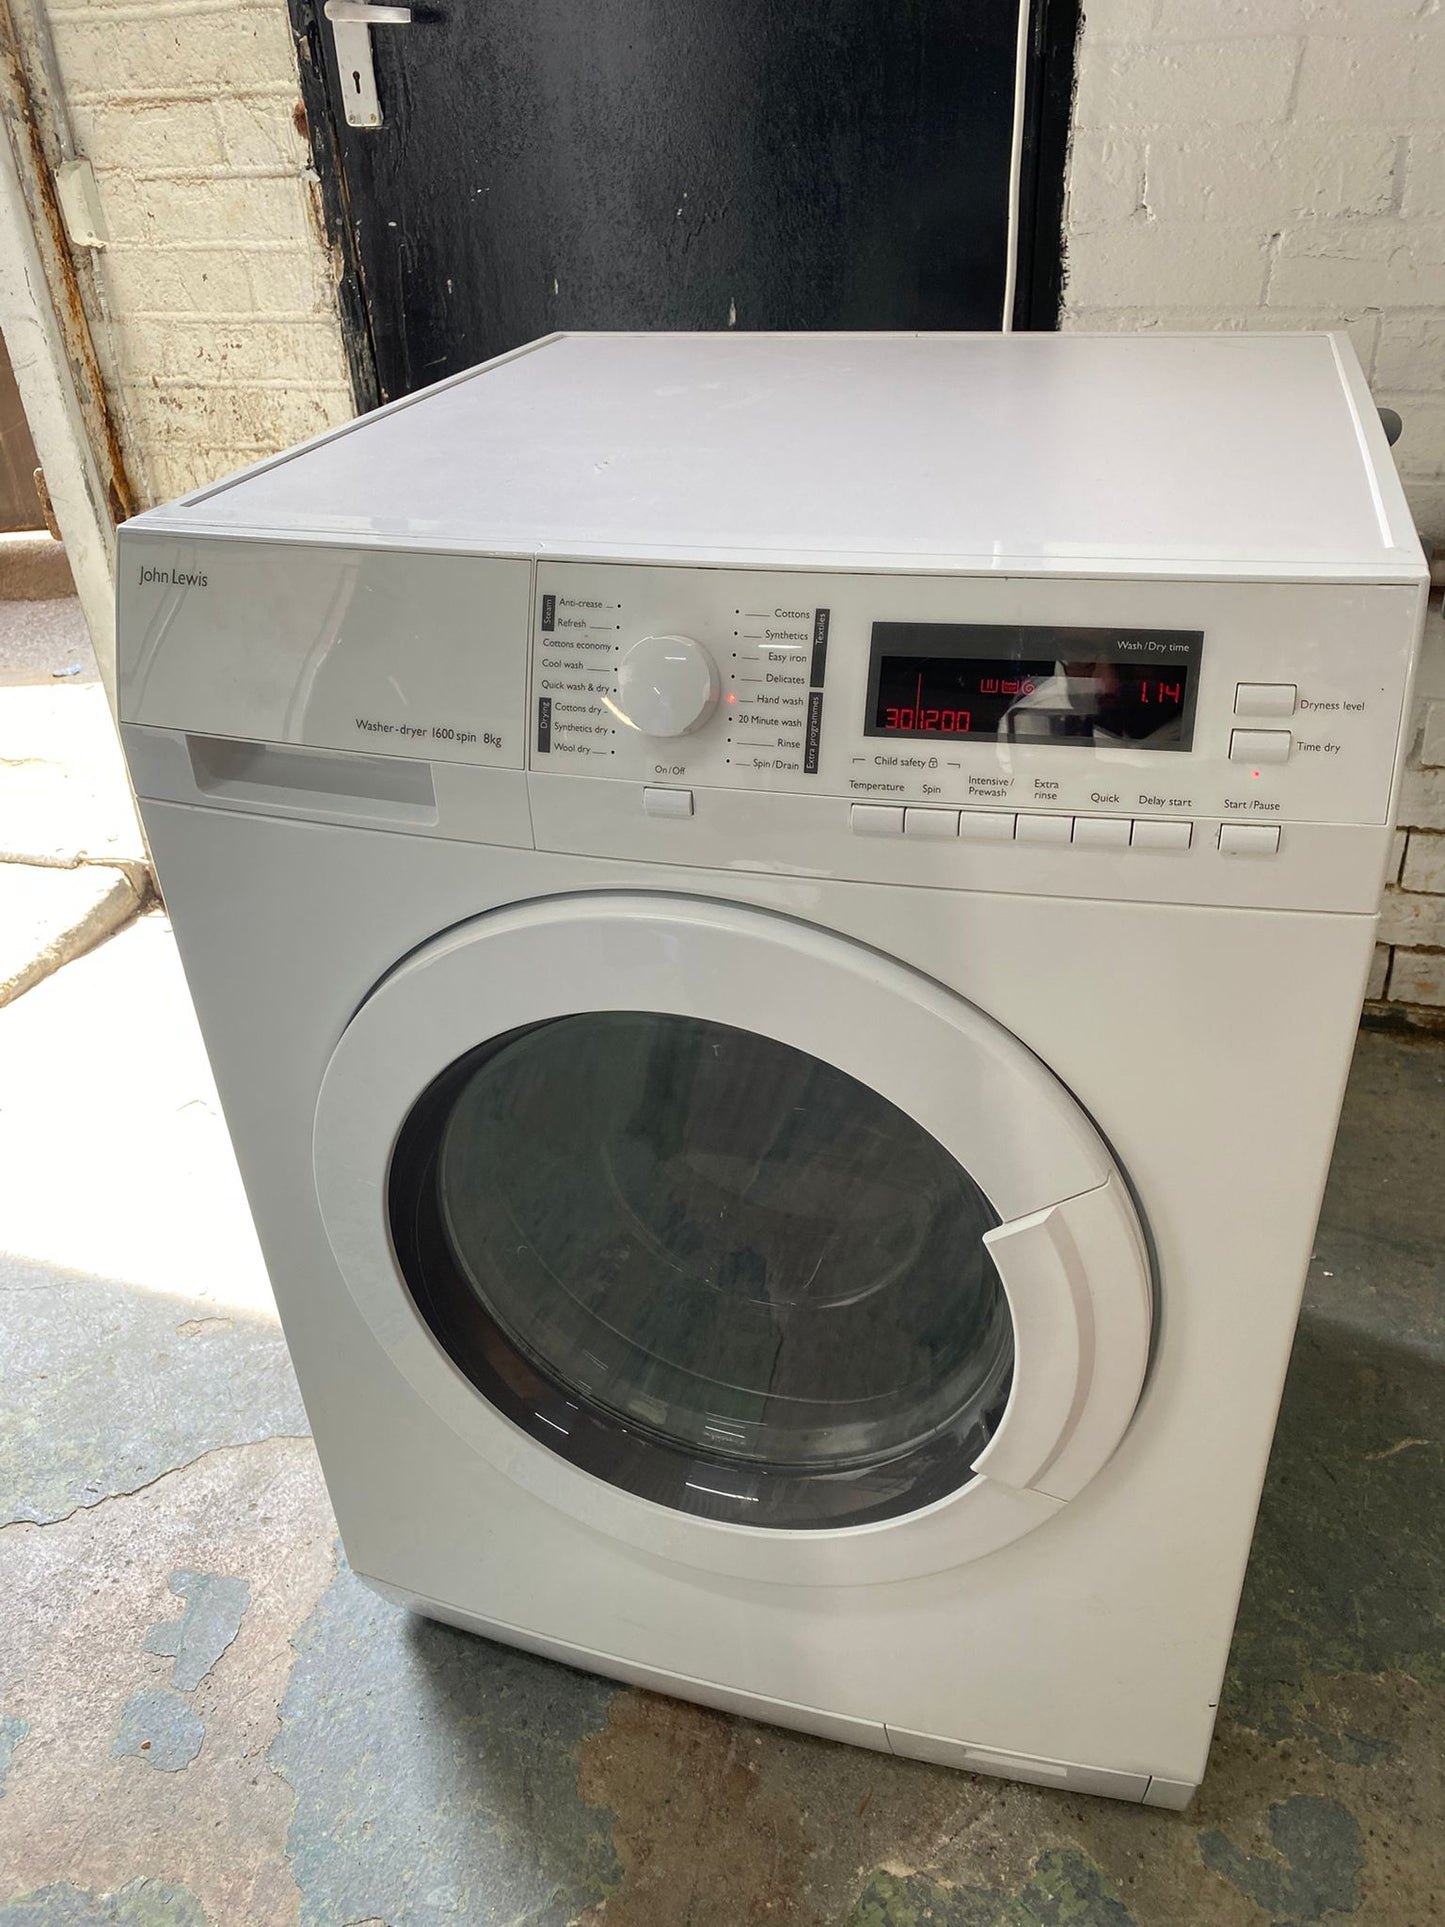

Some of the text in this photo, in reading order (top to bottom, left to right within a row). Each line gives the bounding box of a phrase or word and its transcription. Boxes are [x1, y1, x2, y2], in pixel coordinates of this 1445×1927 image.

[139, 566, 208, 587] John Lewis
[559, 598, 603, 609] Anti-crease
[544, 599, 553, 624] Steam
[774, 608, 810, 619] Cottons
[557, 618, 587, 628] Refresh
[815, 612, 826, 645] Textiles
[765, 629, 809, 641] Synthetics
[543, 638, 611, 652] Cottons economy
[1169, 642, 1190, 652] time
[768, 651, 787, 663] Easy
[542, 659, 584, 669] Cool wash
[766, 673, 805, 685] Delicates
[541, 679, 610, 695] Quick wash & dry
[756, 694, 804, 706] Hand wash
[1300, 699, 1365, 712] Dryness level
[541, 701, 550, 729] Drying
[554, 702, 602, 716] Cottons dry
[738, 714, 802, 728] 20 Minute wash
[355, 718, 502, 748] Washer-dryer 1600 spin 8kg
[554, 721, 609, 736] Synthetics dry
[805, 696, 820, 770] Extra programmes
[554, 743, 591, 756] Wool dry
[777, 738, 801, 749] Rinse
[1297, 741, 1341, 755] Time dry
[874, 755, 927, 769] Child safety
[849, 779, 905, 792] Temperature
[922, 784, 941, 795] Spin
[1034, 778, 1059, 789] Extra
[968, 786, 1007, 797] Prewash
[1034, 790, 1057, 800] rinse
[1090, 791, 1119, 803] Quick
[1138, 794, 1192, 807] Delay start
